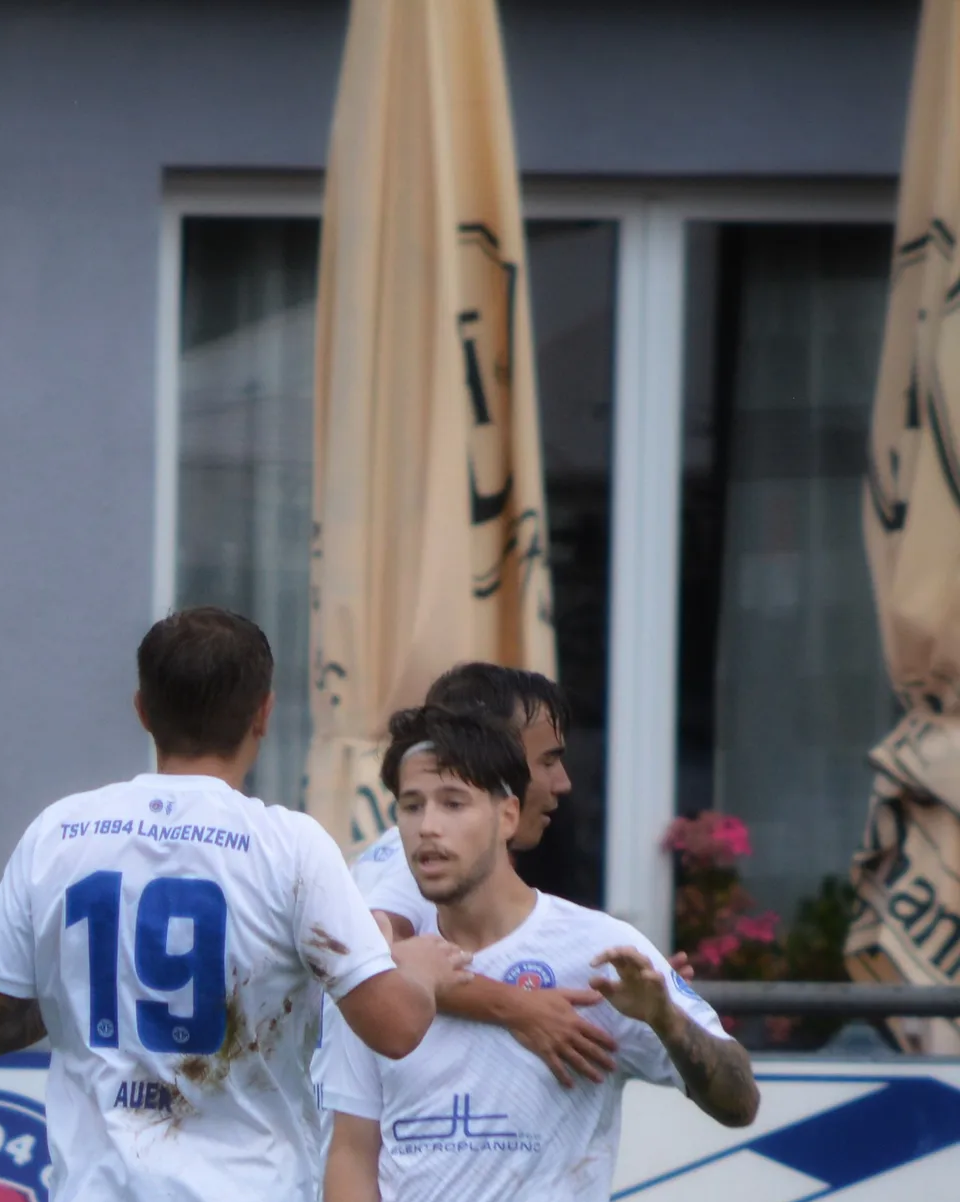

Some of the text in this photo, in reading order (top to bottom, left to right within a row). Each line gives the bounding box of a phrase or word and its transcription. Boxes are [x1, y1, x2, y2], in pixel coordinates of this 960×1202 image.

[61, 819, 251, 853] TSV 1894 LANGENZENN
[64, 869, 228, 1053] 19
